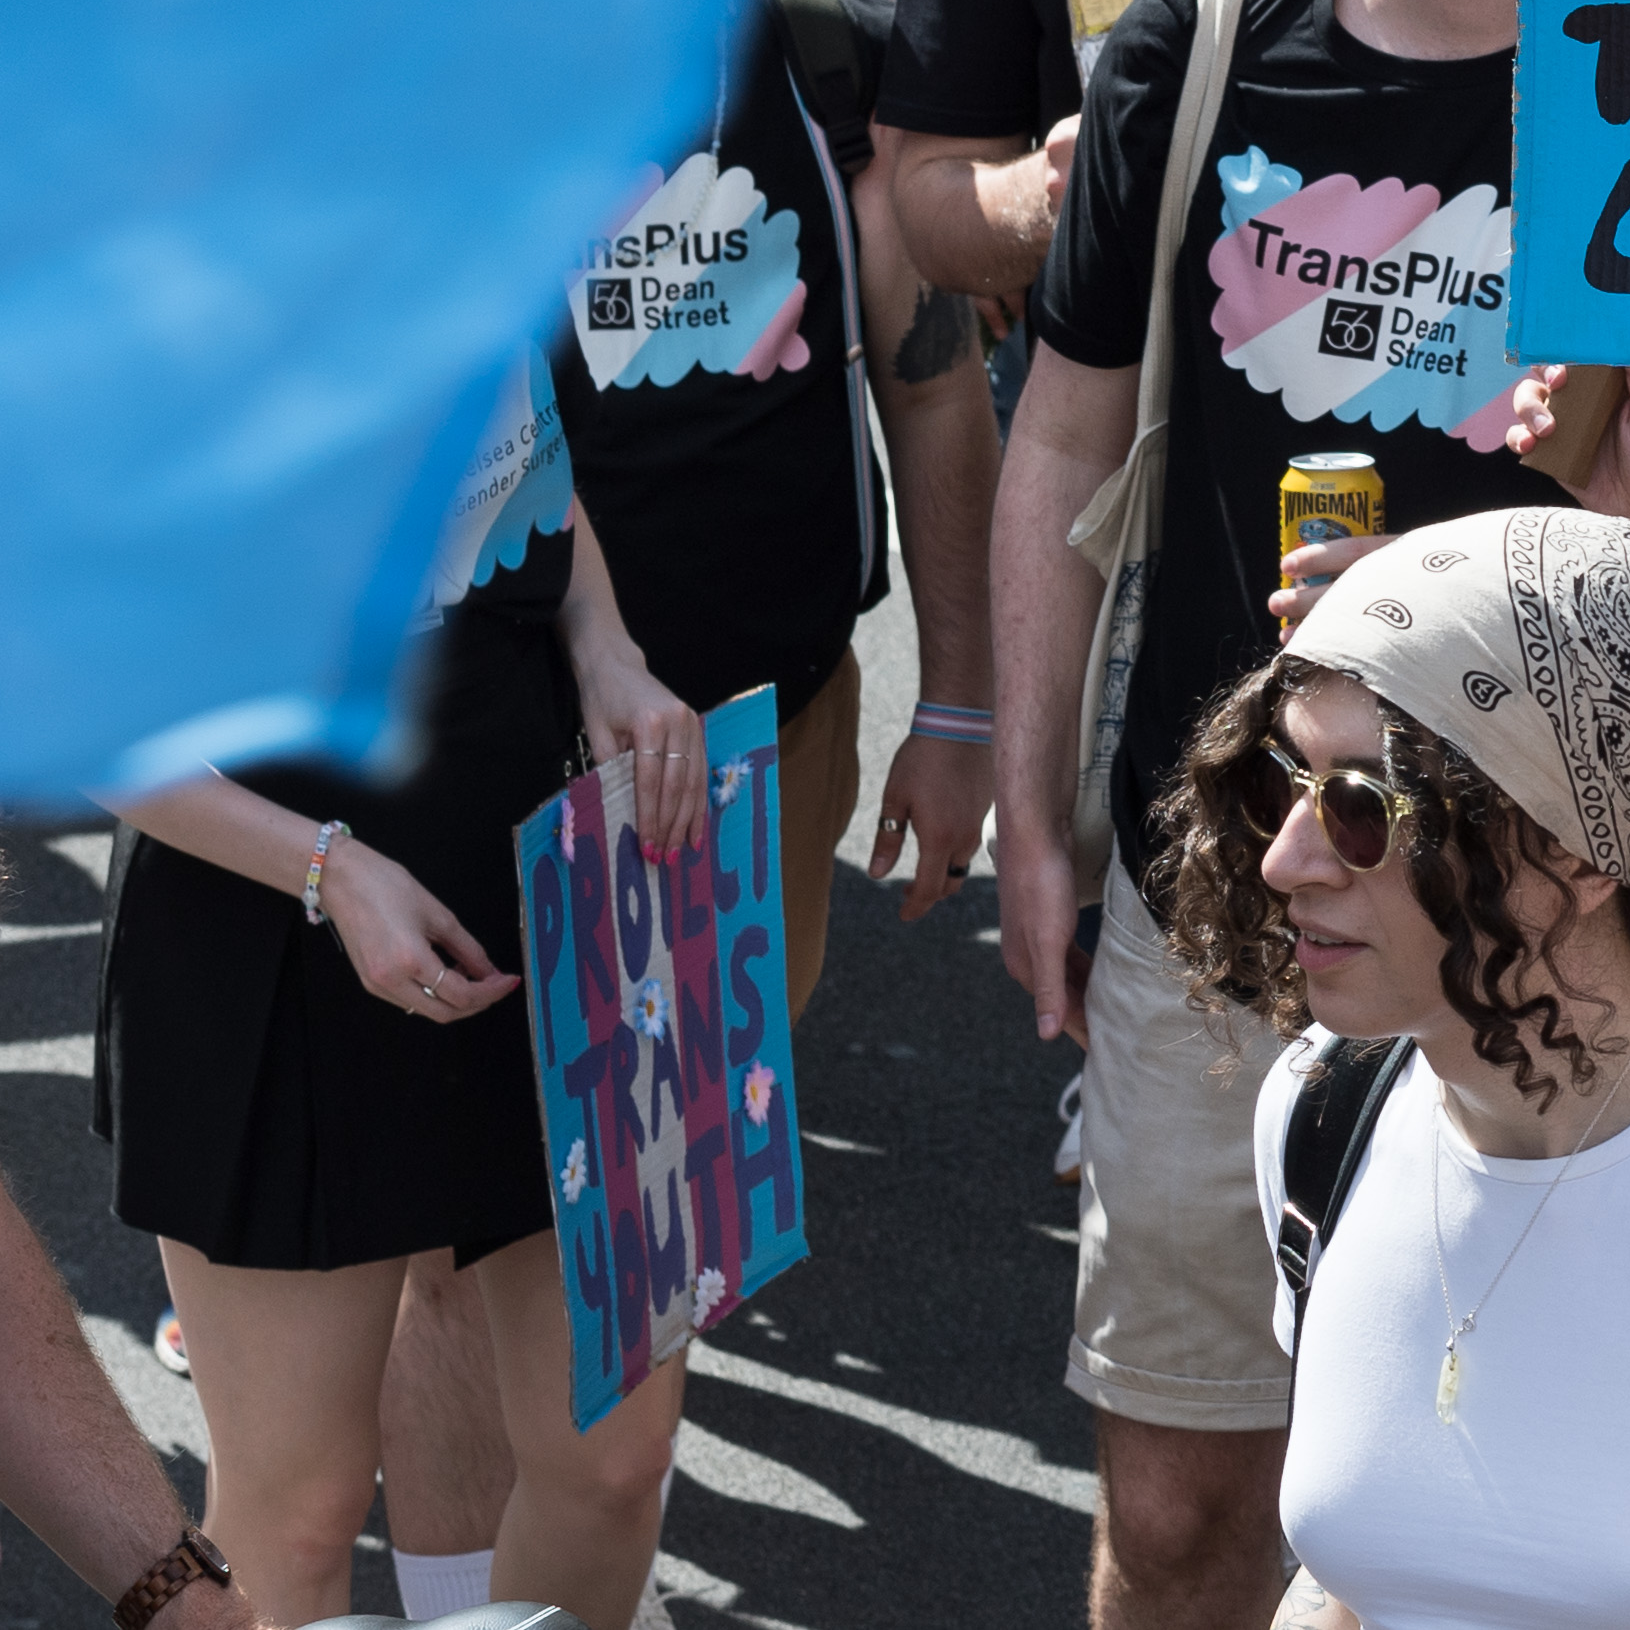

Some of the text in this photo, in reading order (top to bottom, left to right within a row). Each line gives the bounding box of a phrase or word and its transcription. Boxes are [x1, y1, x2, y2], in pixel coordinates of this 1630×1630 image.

[1248, 217, 1506, 312] TransPlus
[641, 276, 715, 302] Dean
[644, 300, 732, 331] Street
[1390, 306, 1457, 345] Dean
[1386, 339, 1469, 378] Street
[1284, 490, 1370, 531] WINGMAN
[563, 923, 771, 1190] TRANS
